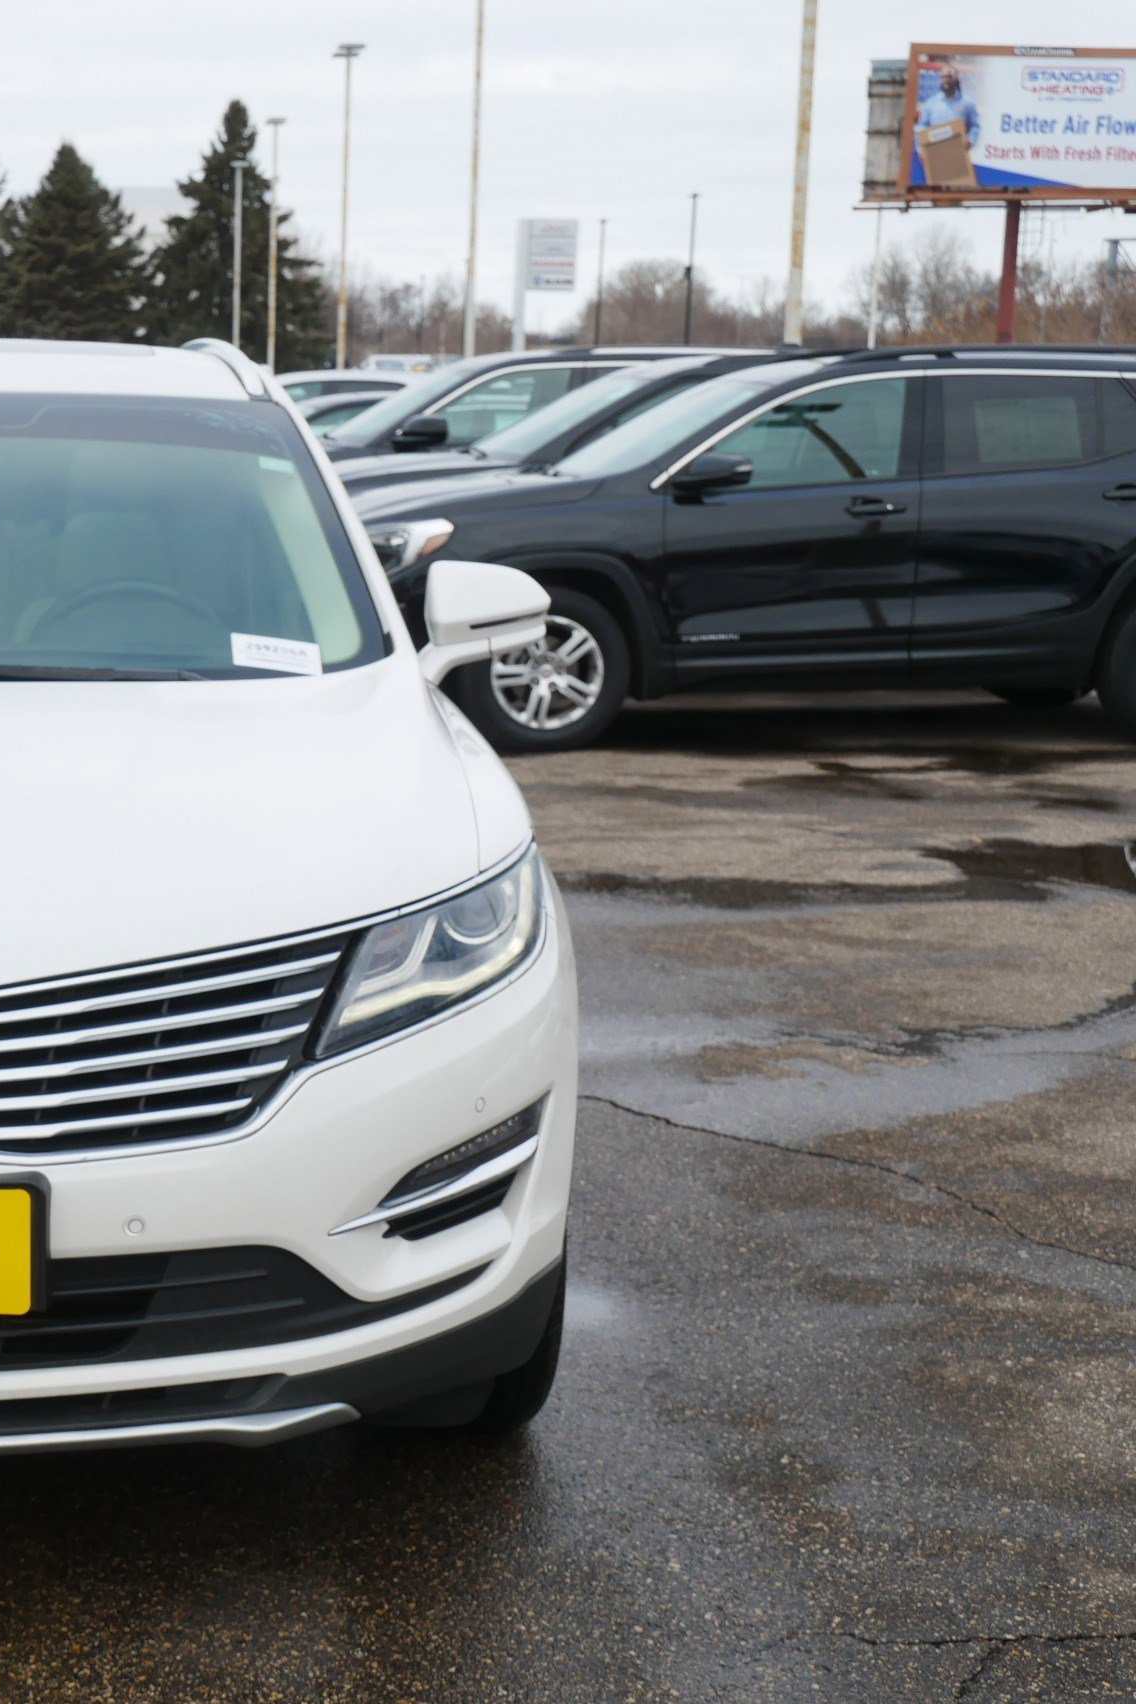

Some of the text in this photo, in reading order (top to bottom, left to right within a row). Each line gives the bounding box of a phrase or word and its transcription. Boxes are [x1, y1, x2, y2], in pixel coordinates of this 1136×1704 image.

[1027, 70, 1120, 83] STANDARD
[1038, 84, 1104, 95] HEATING
[1001, 112, 1136, 135] Better Air Flow
[985, 144, 1025, 159] Starts
[1030, 145, 1059, 160] With
[1065, 146, 1102, 160] Fresh
